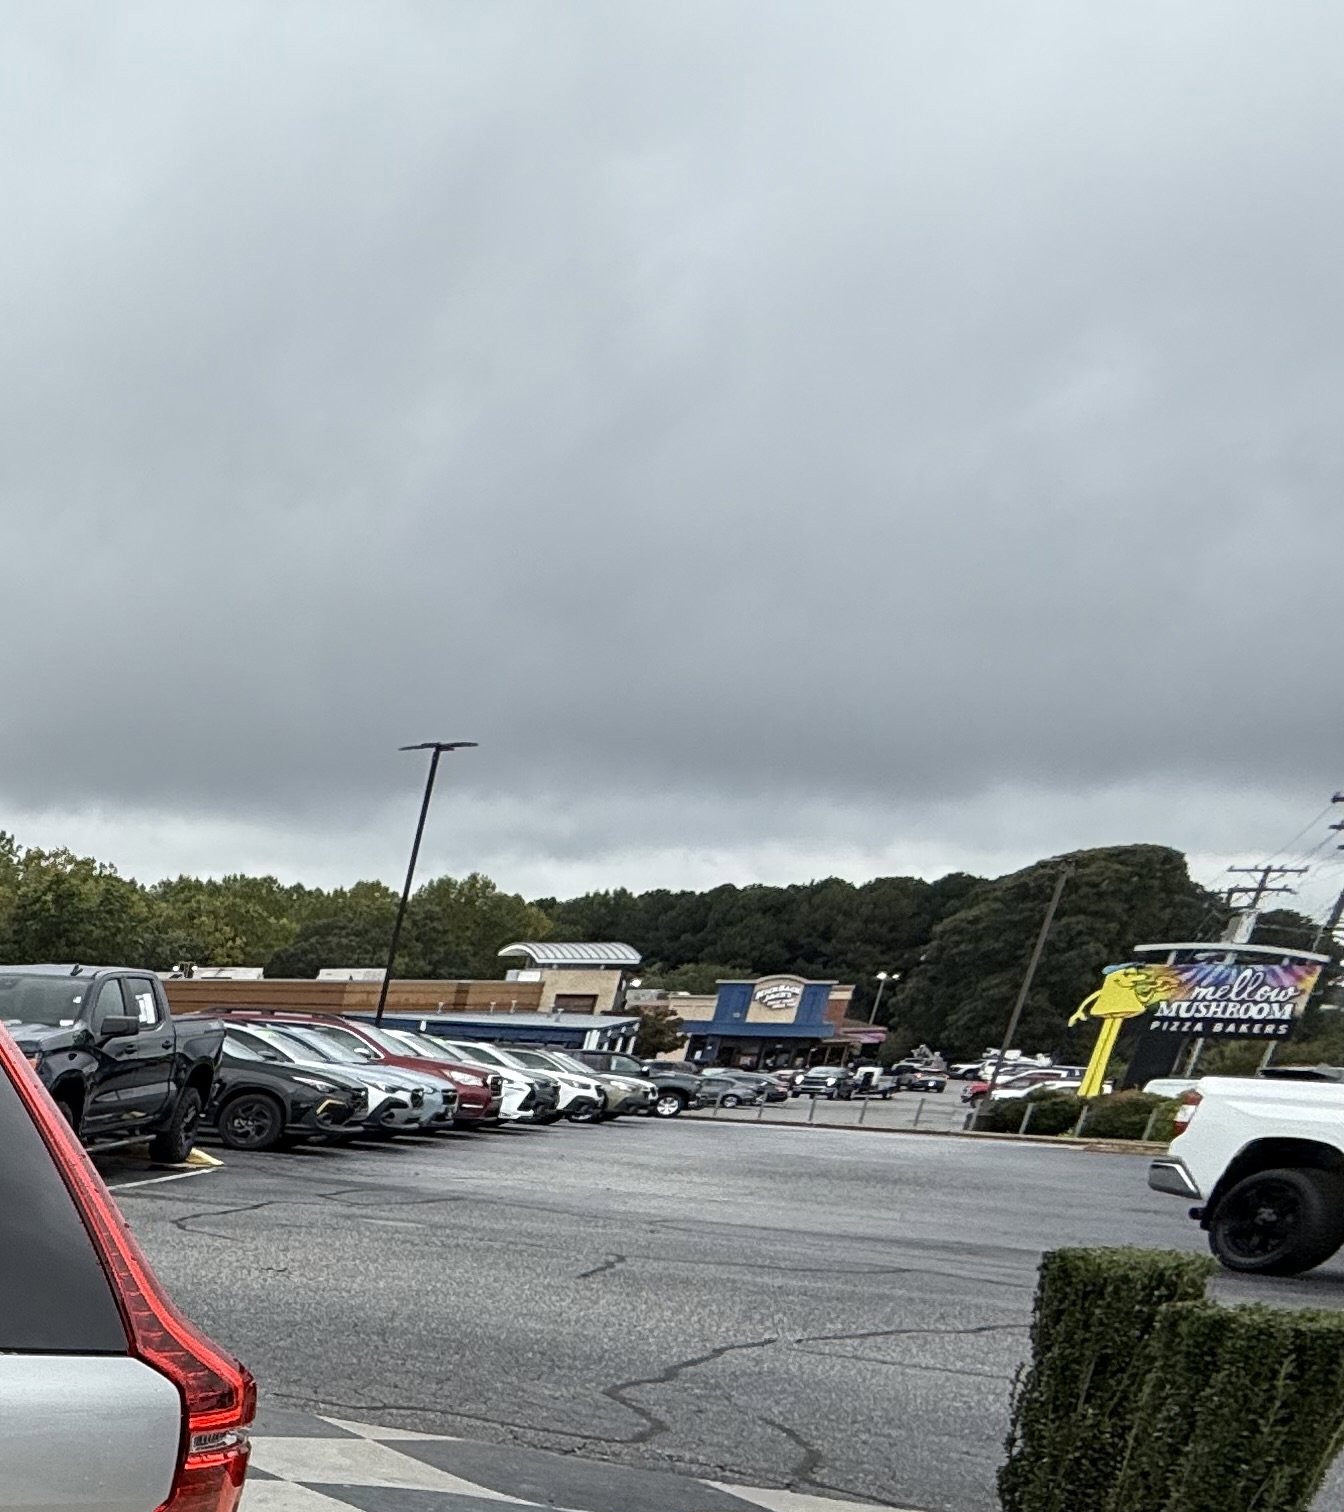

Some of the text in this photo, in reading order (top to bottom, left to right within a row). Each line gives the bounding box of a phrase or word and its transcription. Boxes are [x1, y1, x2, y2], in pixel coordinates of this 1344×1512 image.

[1189, 968, 1300, 1001] mellow
[1154, 1001, 1294, 1020] MUSHROOM
[1149, 1021, 1290, 1034] PIZZA BAKERS
